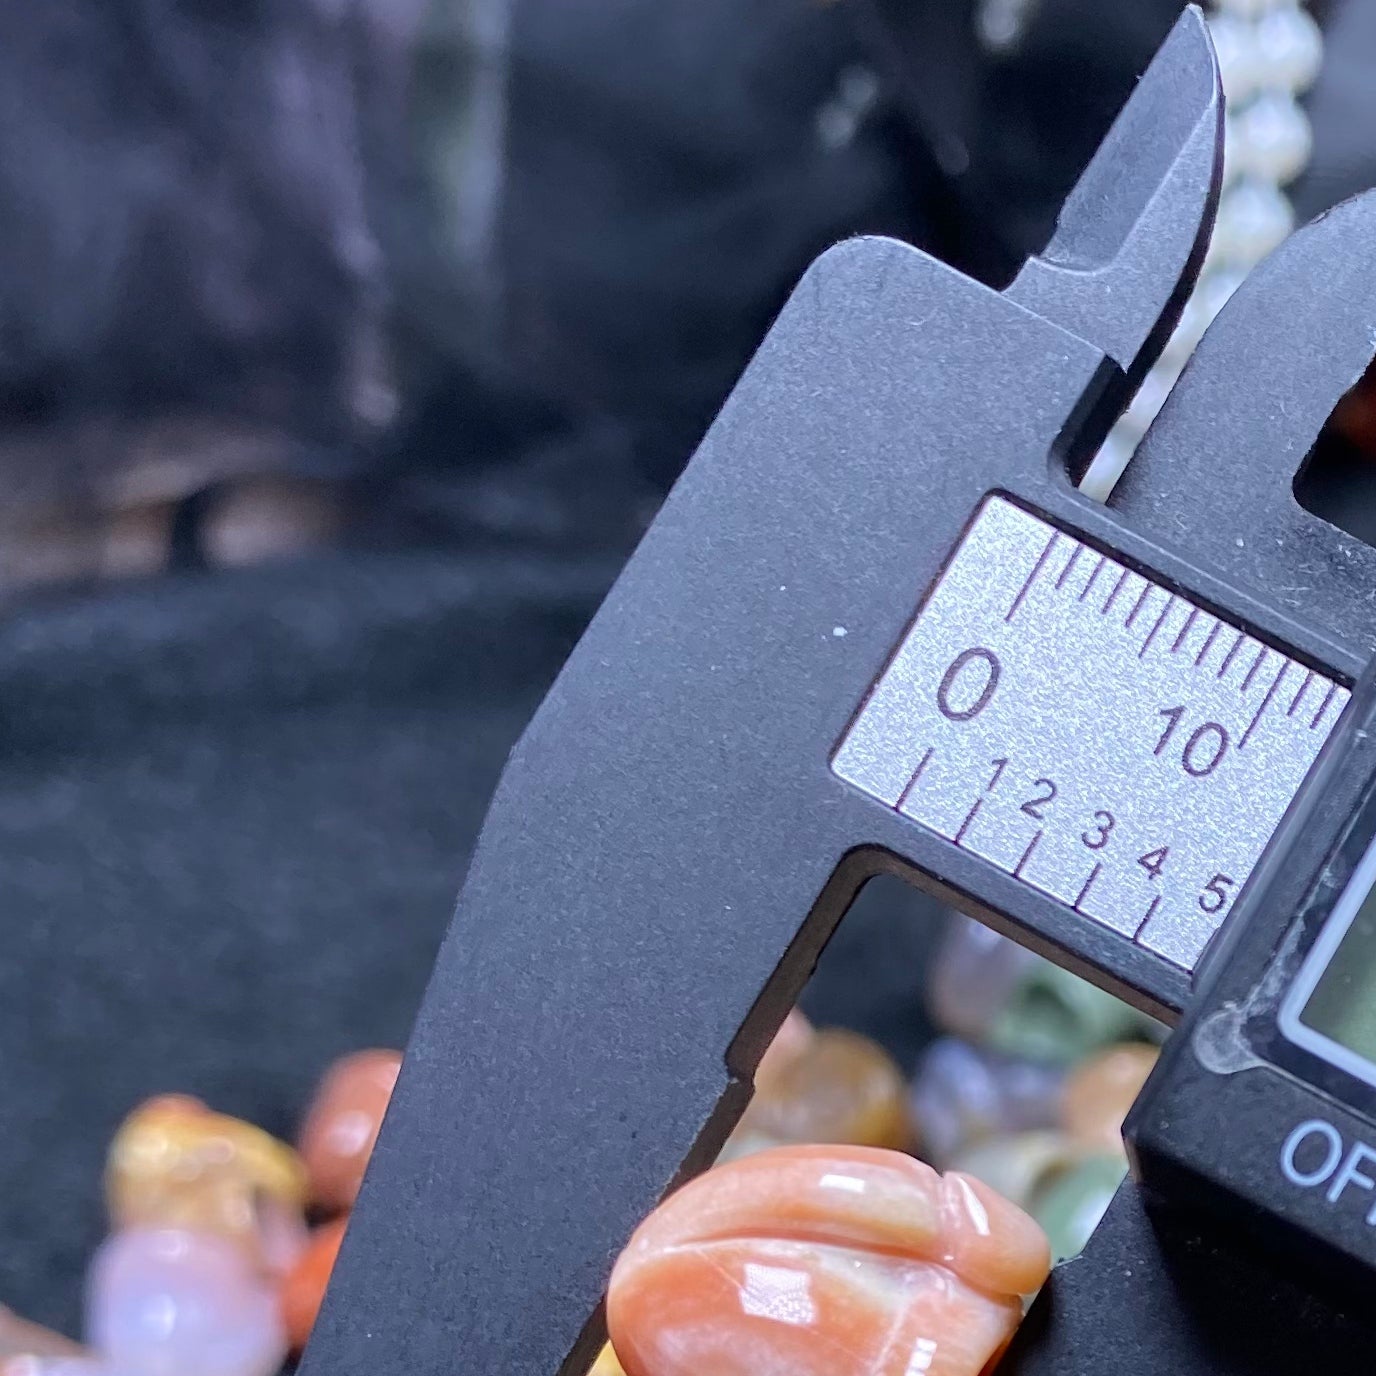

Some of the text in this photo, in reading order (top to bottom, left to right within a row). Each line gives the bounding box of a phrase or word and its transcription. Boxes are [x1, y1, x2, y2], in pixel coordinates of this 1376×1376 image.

[938, 647, 1230, 777] 0 10
[987, 757, 1234, 914] 1 2 3 4 5
